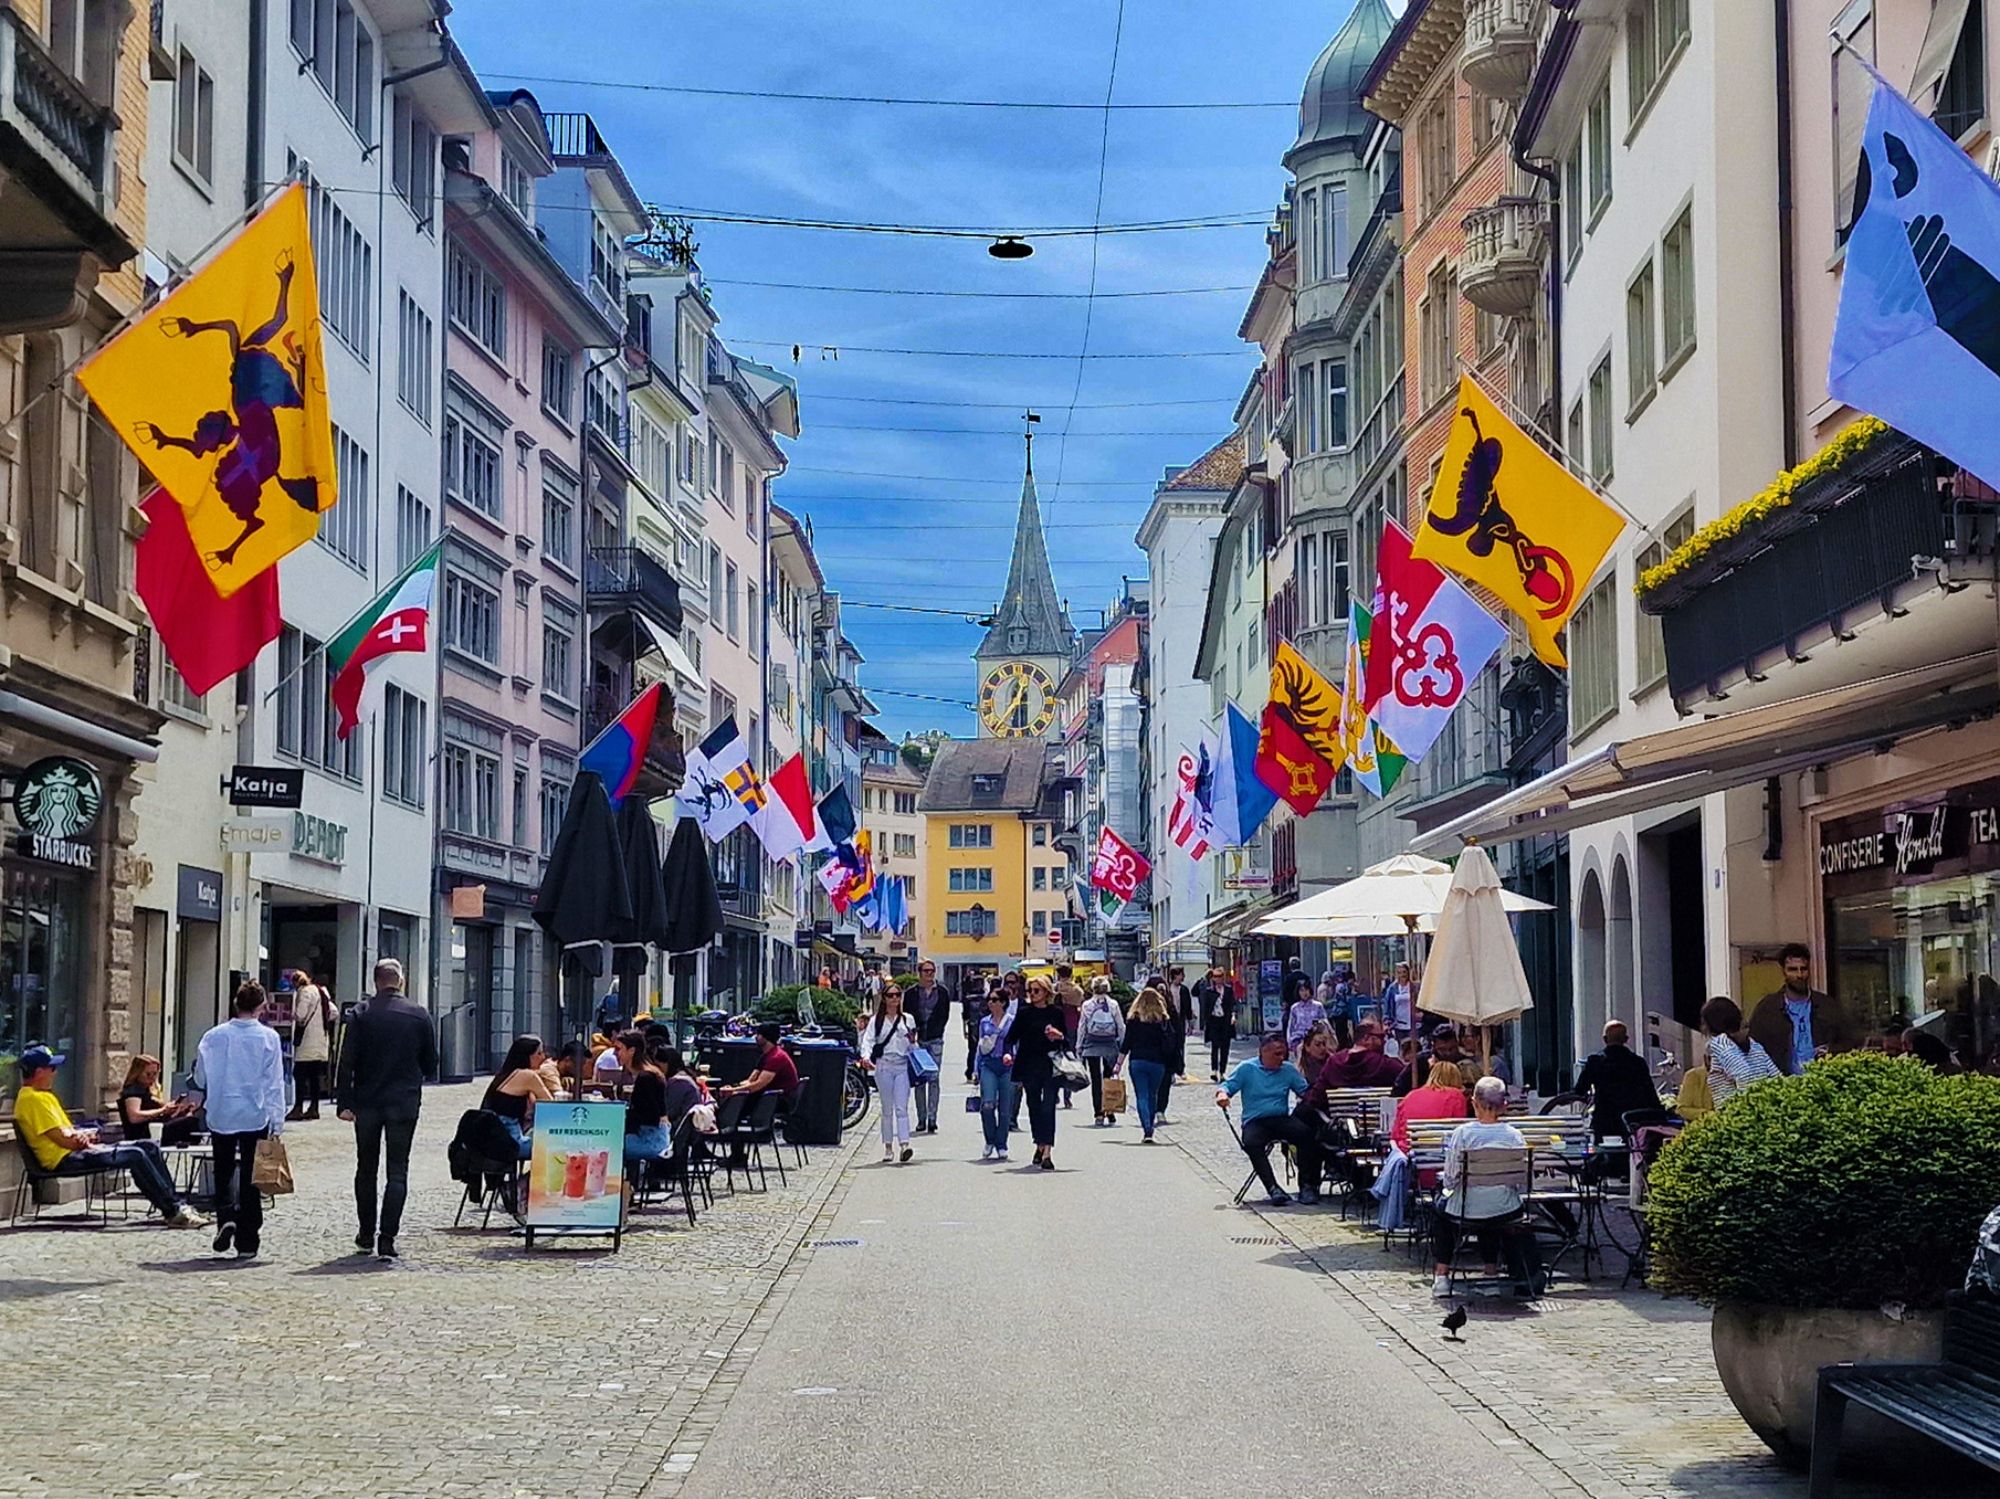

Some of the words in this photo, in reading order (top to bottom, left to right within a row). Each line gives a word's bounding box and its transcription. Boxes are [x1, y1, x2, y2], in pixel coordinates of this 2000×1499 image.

[235, 776, 287, 798] Katja
[32, 832, 92, 868] STARBUCKS
[231, 823, 282, 844] maje
[293, 810, 348, 861] DEPOT
[1820, 833, 1884, 875] CONFISERIE
[1895, 804, 1946, 874] Honold
[1970, 807, 1999, 844] TEA
